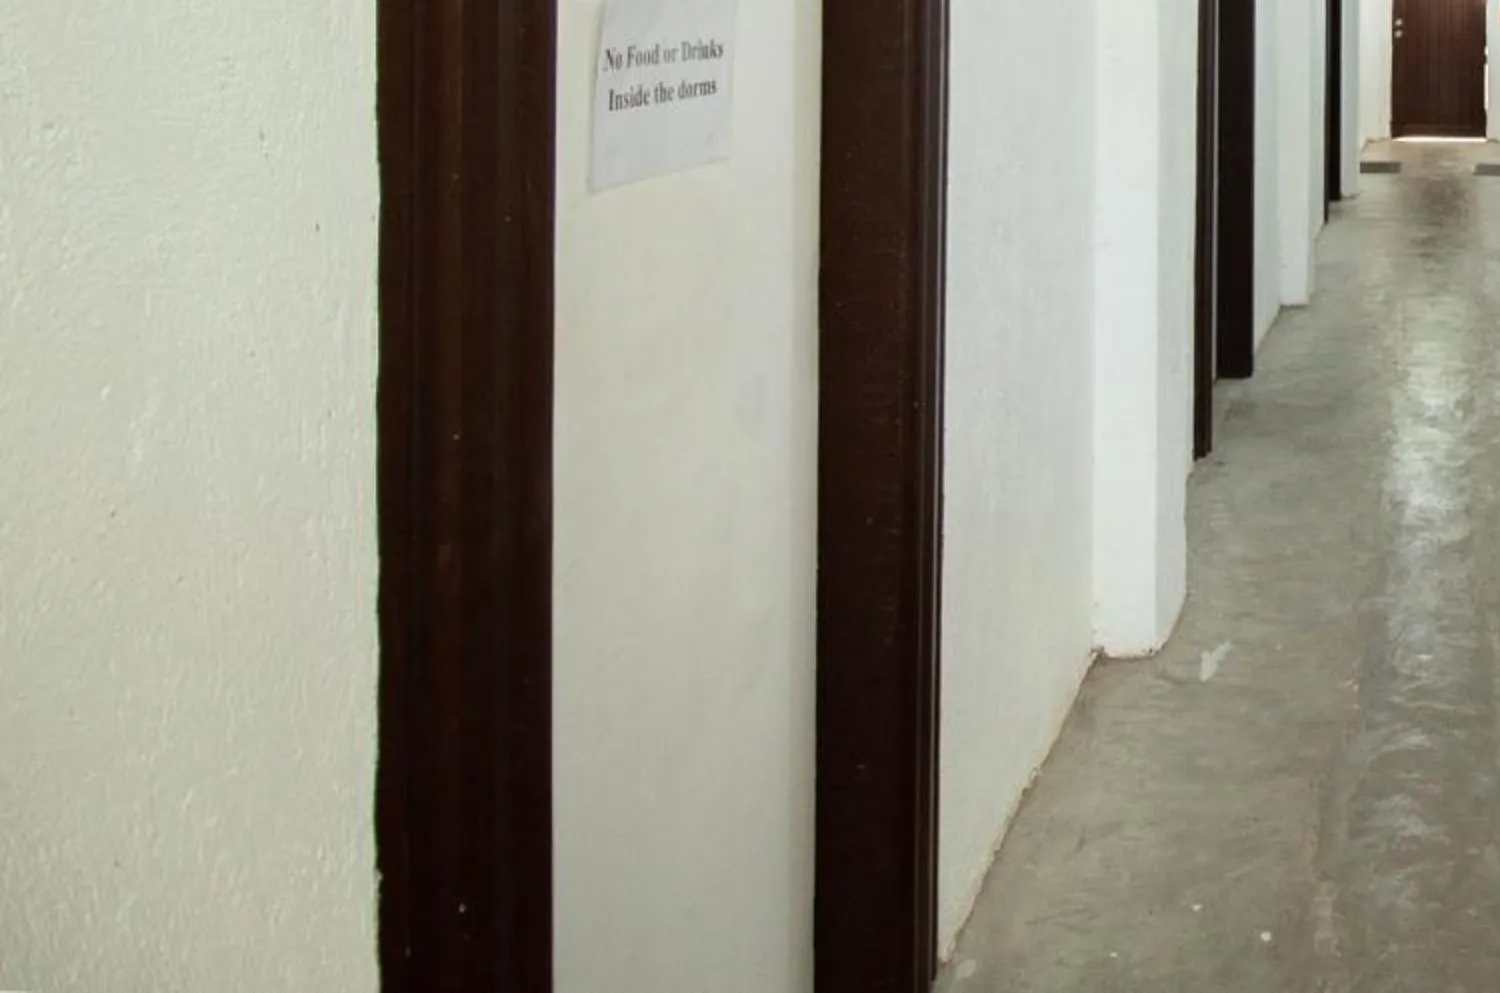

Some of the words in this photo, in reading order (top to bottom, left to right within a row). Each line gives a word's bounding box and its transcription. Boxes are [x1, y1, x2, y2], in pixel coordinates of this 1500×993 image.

[603, 47, 623, 72] No
[626, 43, 660, 69] Food
[663, 47, 679, 64] or
[681, 38, 724, 63] Drinks
[608, 84, 651, 112] Inside
[653, 81, 675, 105] the
[677, 79, 718, 100] dorms
